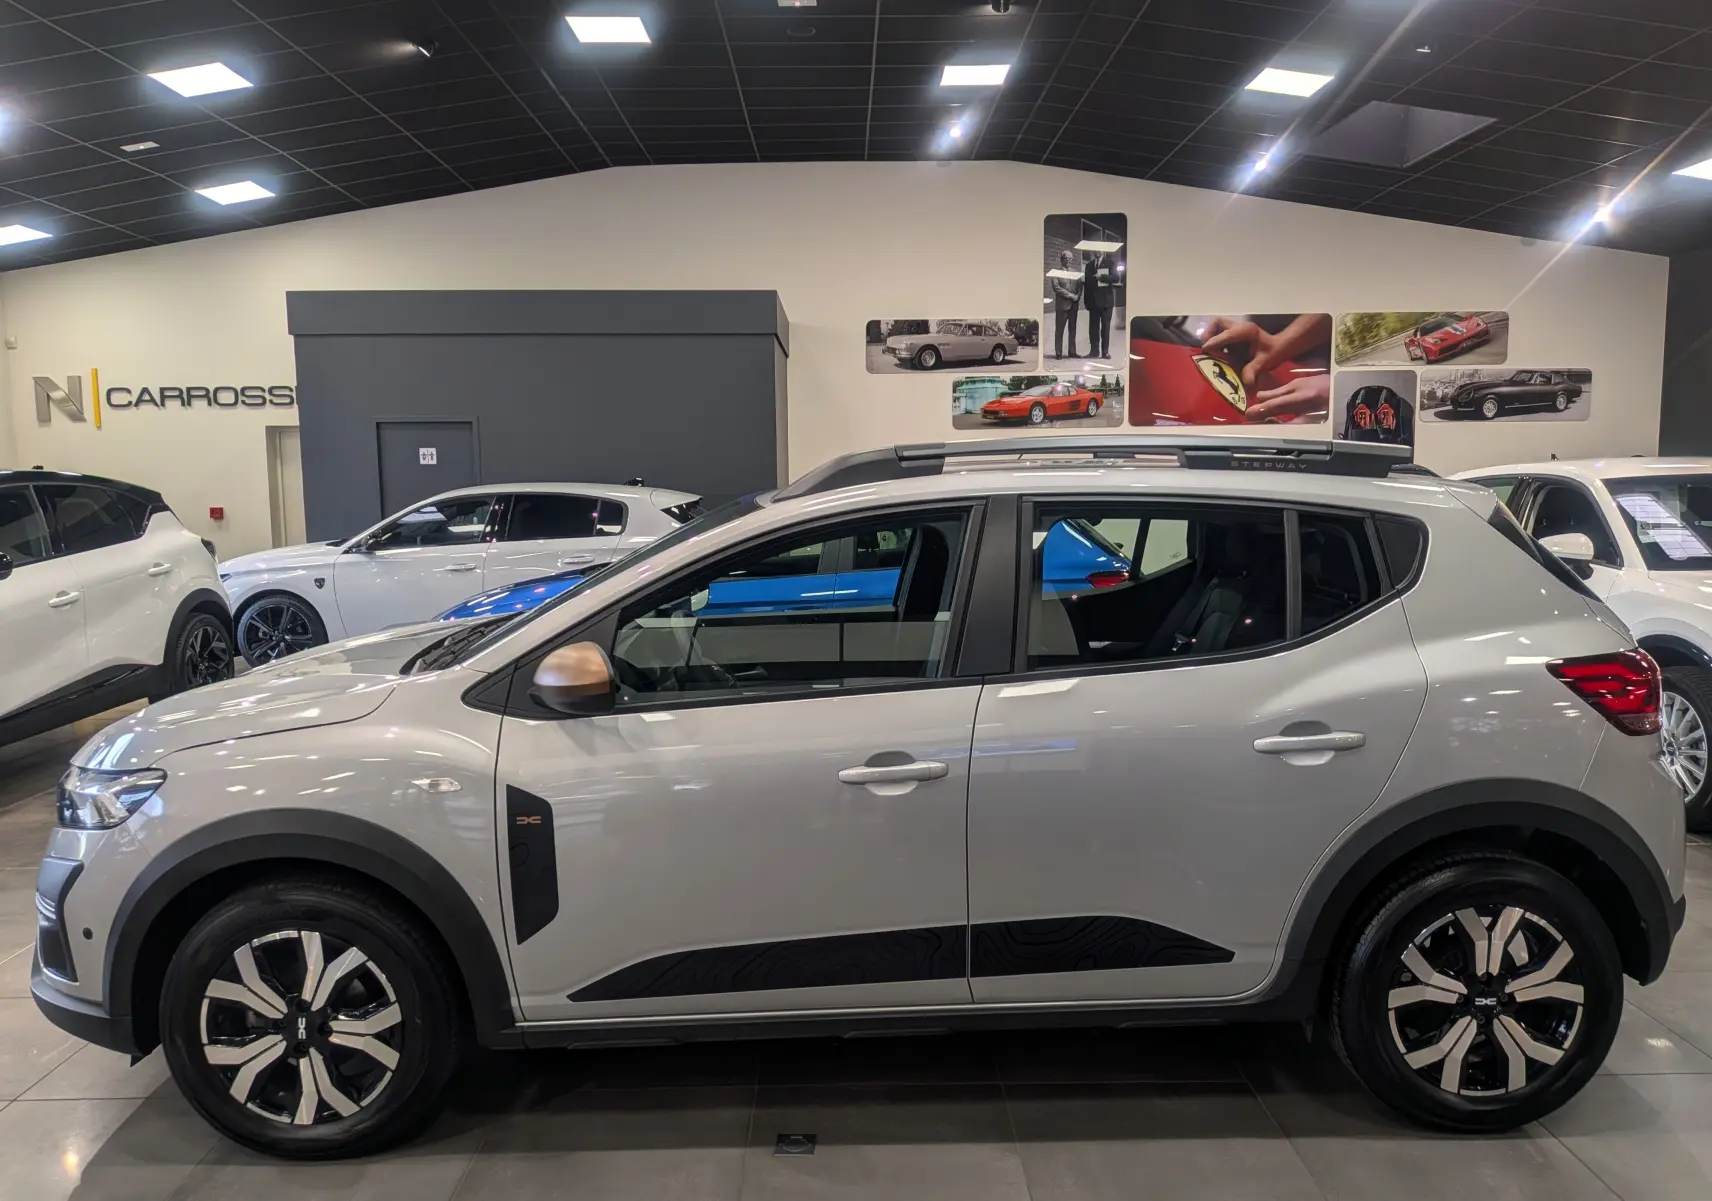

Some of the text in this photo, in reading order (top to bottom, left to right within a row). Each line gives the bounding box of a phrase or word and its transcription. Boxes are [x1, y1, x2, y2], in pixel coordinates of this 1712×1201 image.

[32, 375, 297, 423] N CARROSS
[1230, 460, 1307, 469] STEPWAY
